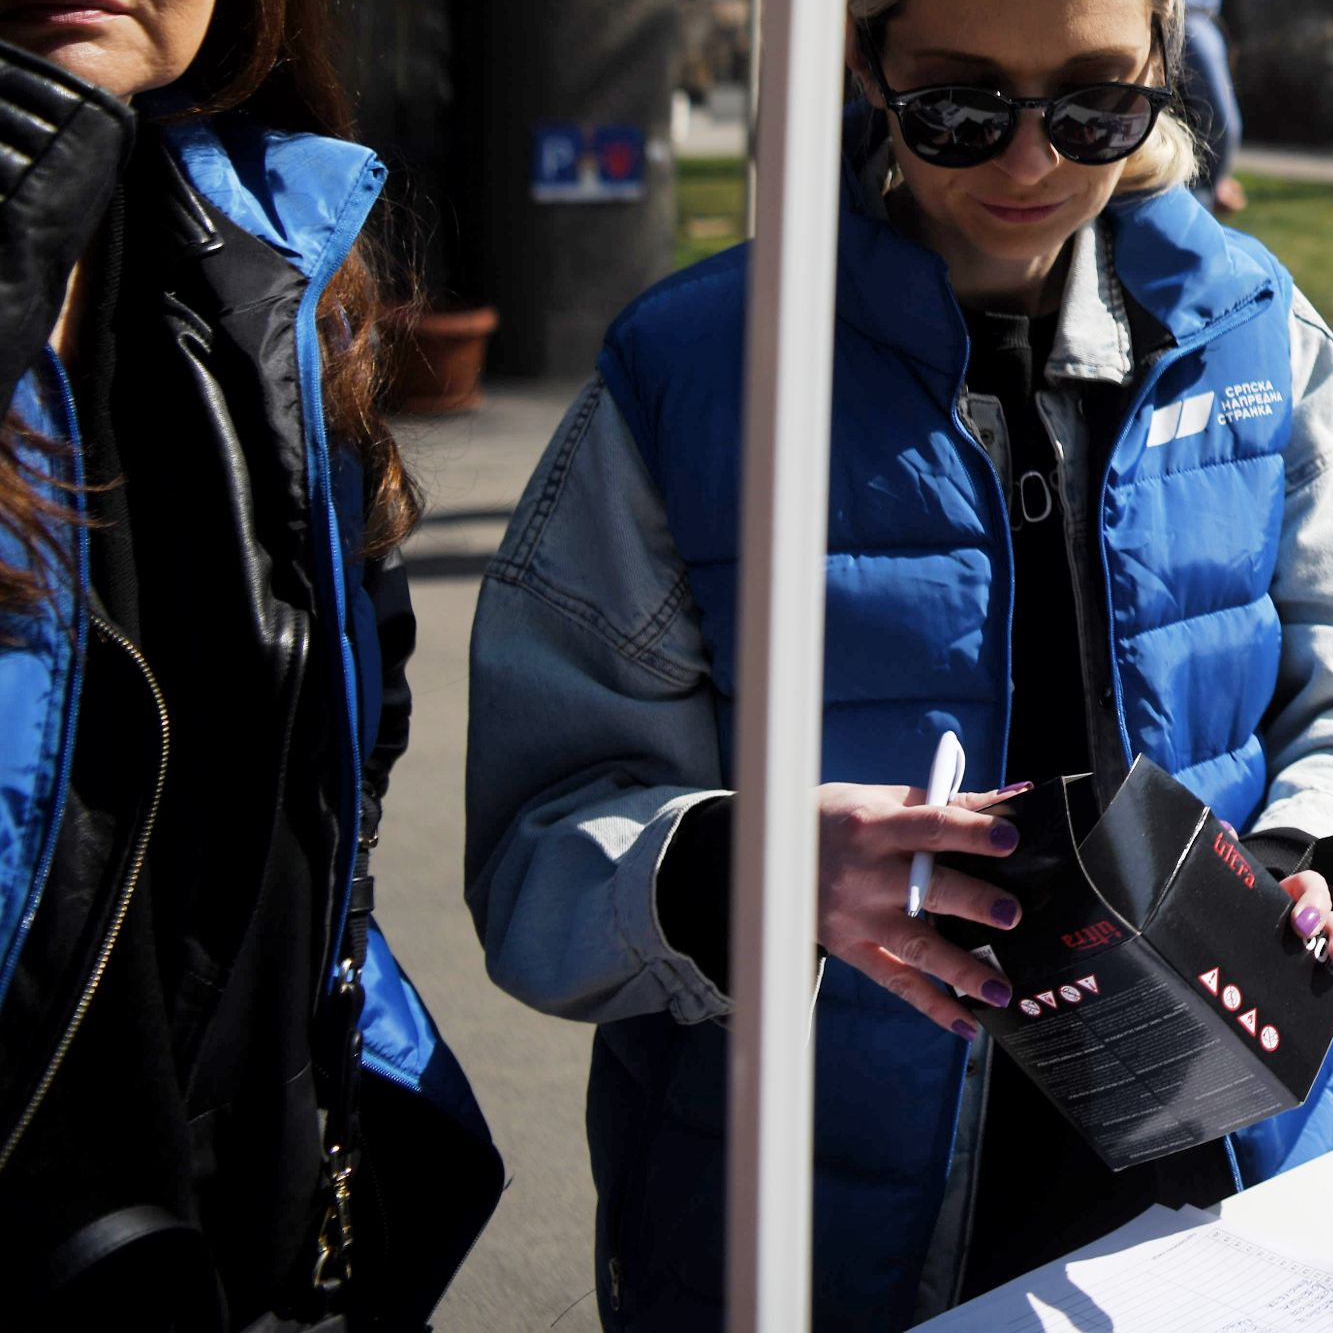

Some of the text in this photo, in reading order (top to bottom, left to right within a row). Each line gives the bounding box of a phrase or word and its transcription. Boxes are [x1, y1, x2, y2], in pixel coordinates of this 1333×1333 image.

[1225, 380, 1274, 398] СРПСКА
[1221, 390, 1284, 412] НАПРЕДНА
[1216, 404, 1274, 426] СТРАНКА
